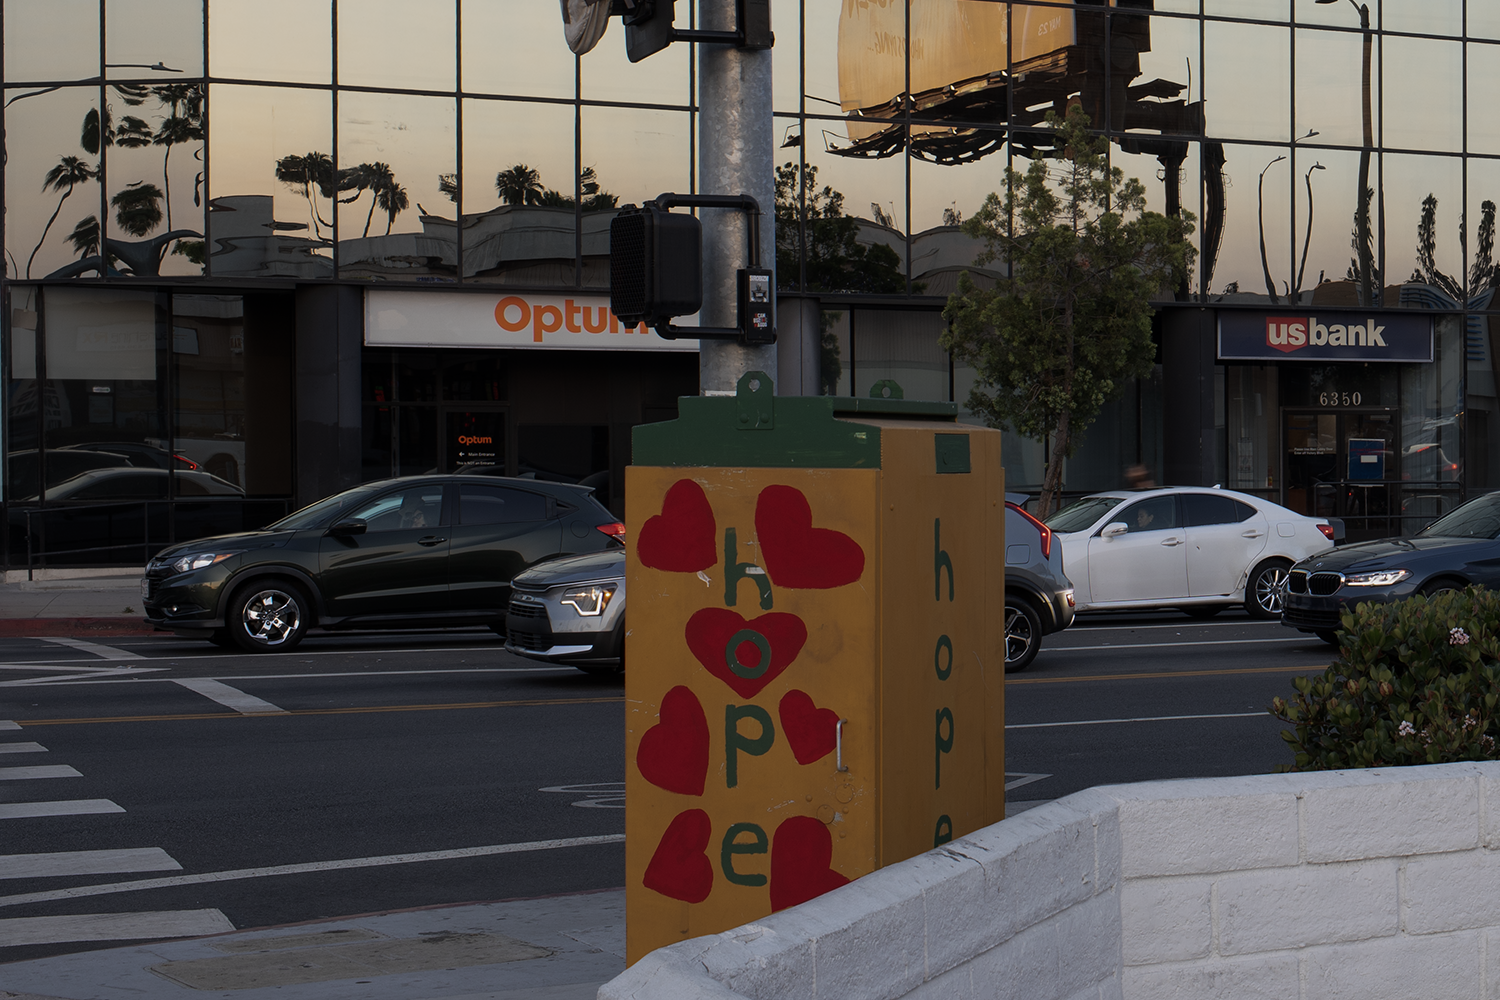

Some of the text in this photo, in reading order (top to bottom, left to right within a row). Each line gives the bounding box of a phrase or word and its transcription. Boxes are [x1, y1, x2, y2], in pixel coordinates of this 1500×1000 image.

[458, 435, 492, 446] Optum
[1319, 391, 1362, 406] 6350
[721, 526, 775, 886] hope
[934, 517, 955, 848] hope
